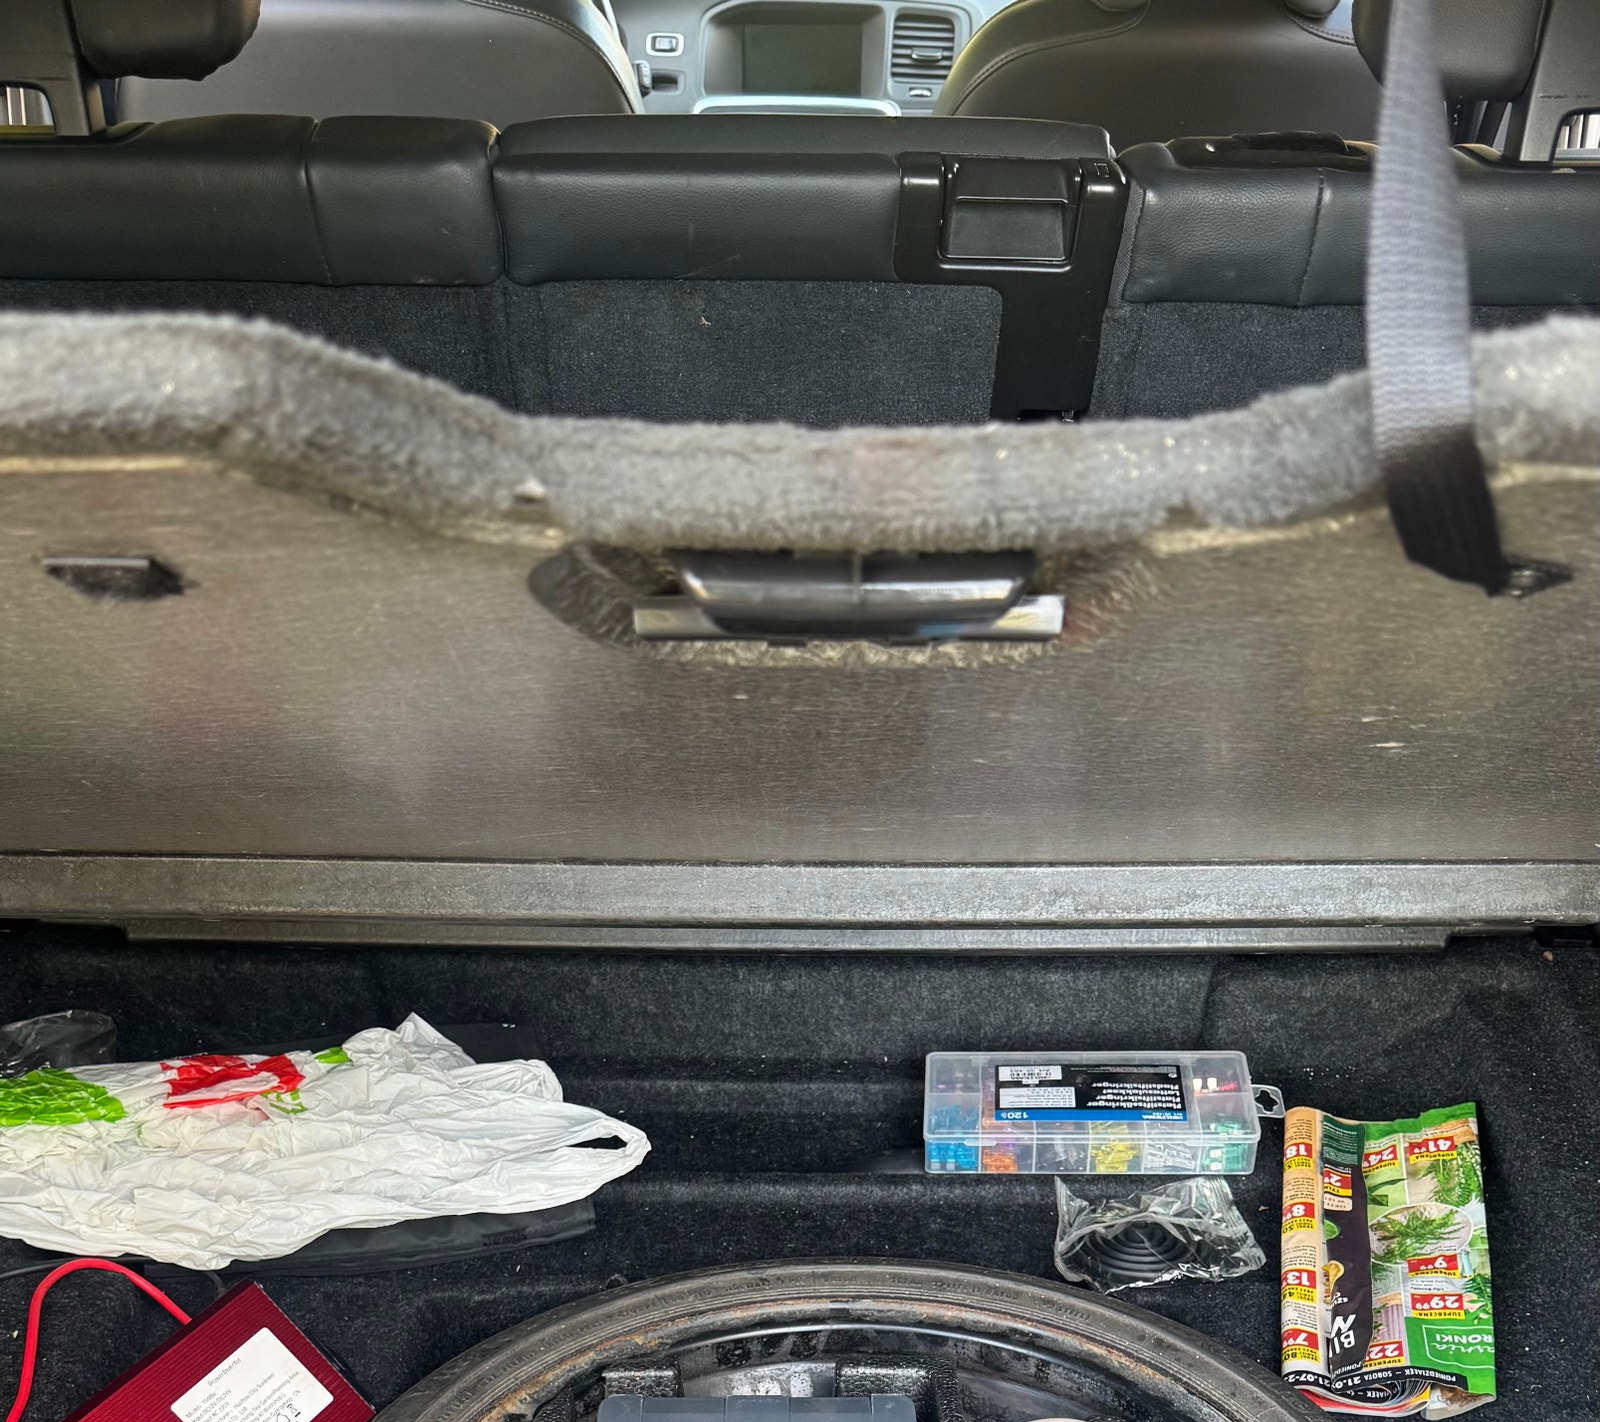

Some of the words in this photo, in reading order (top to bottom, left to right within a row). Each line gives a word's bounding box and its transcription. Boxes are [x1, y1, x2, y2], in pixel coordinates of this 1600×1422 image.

[1435, 1333, 1491, 1343] RONKI
[1363, 1370, 1392, 1379] SOBOTA
[1404, 1368, 1455, 1381] PONIEDZIAŁEK
